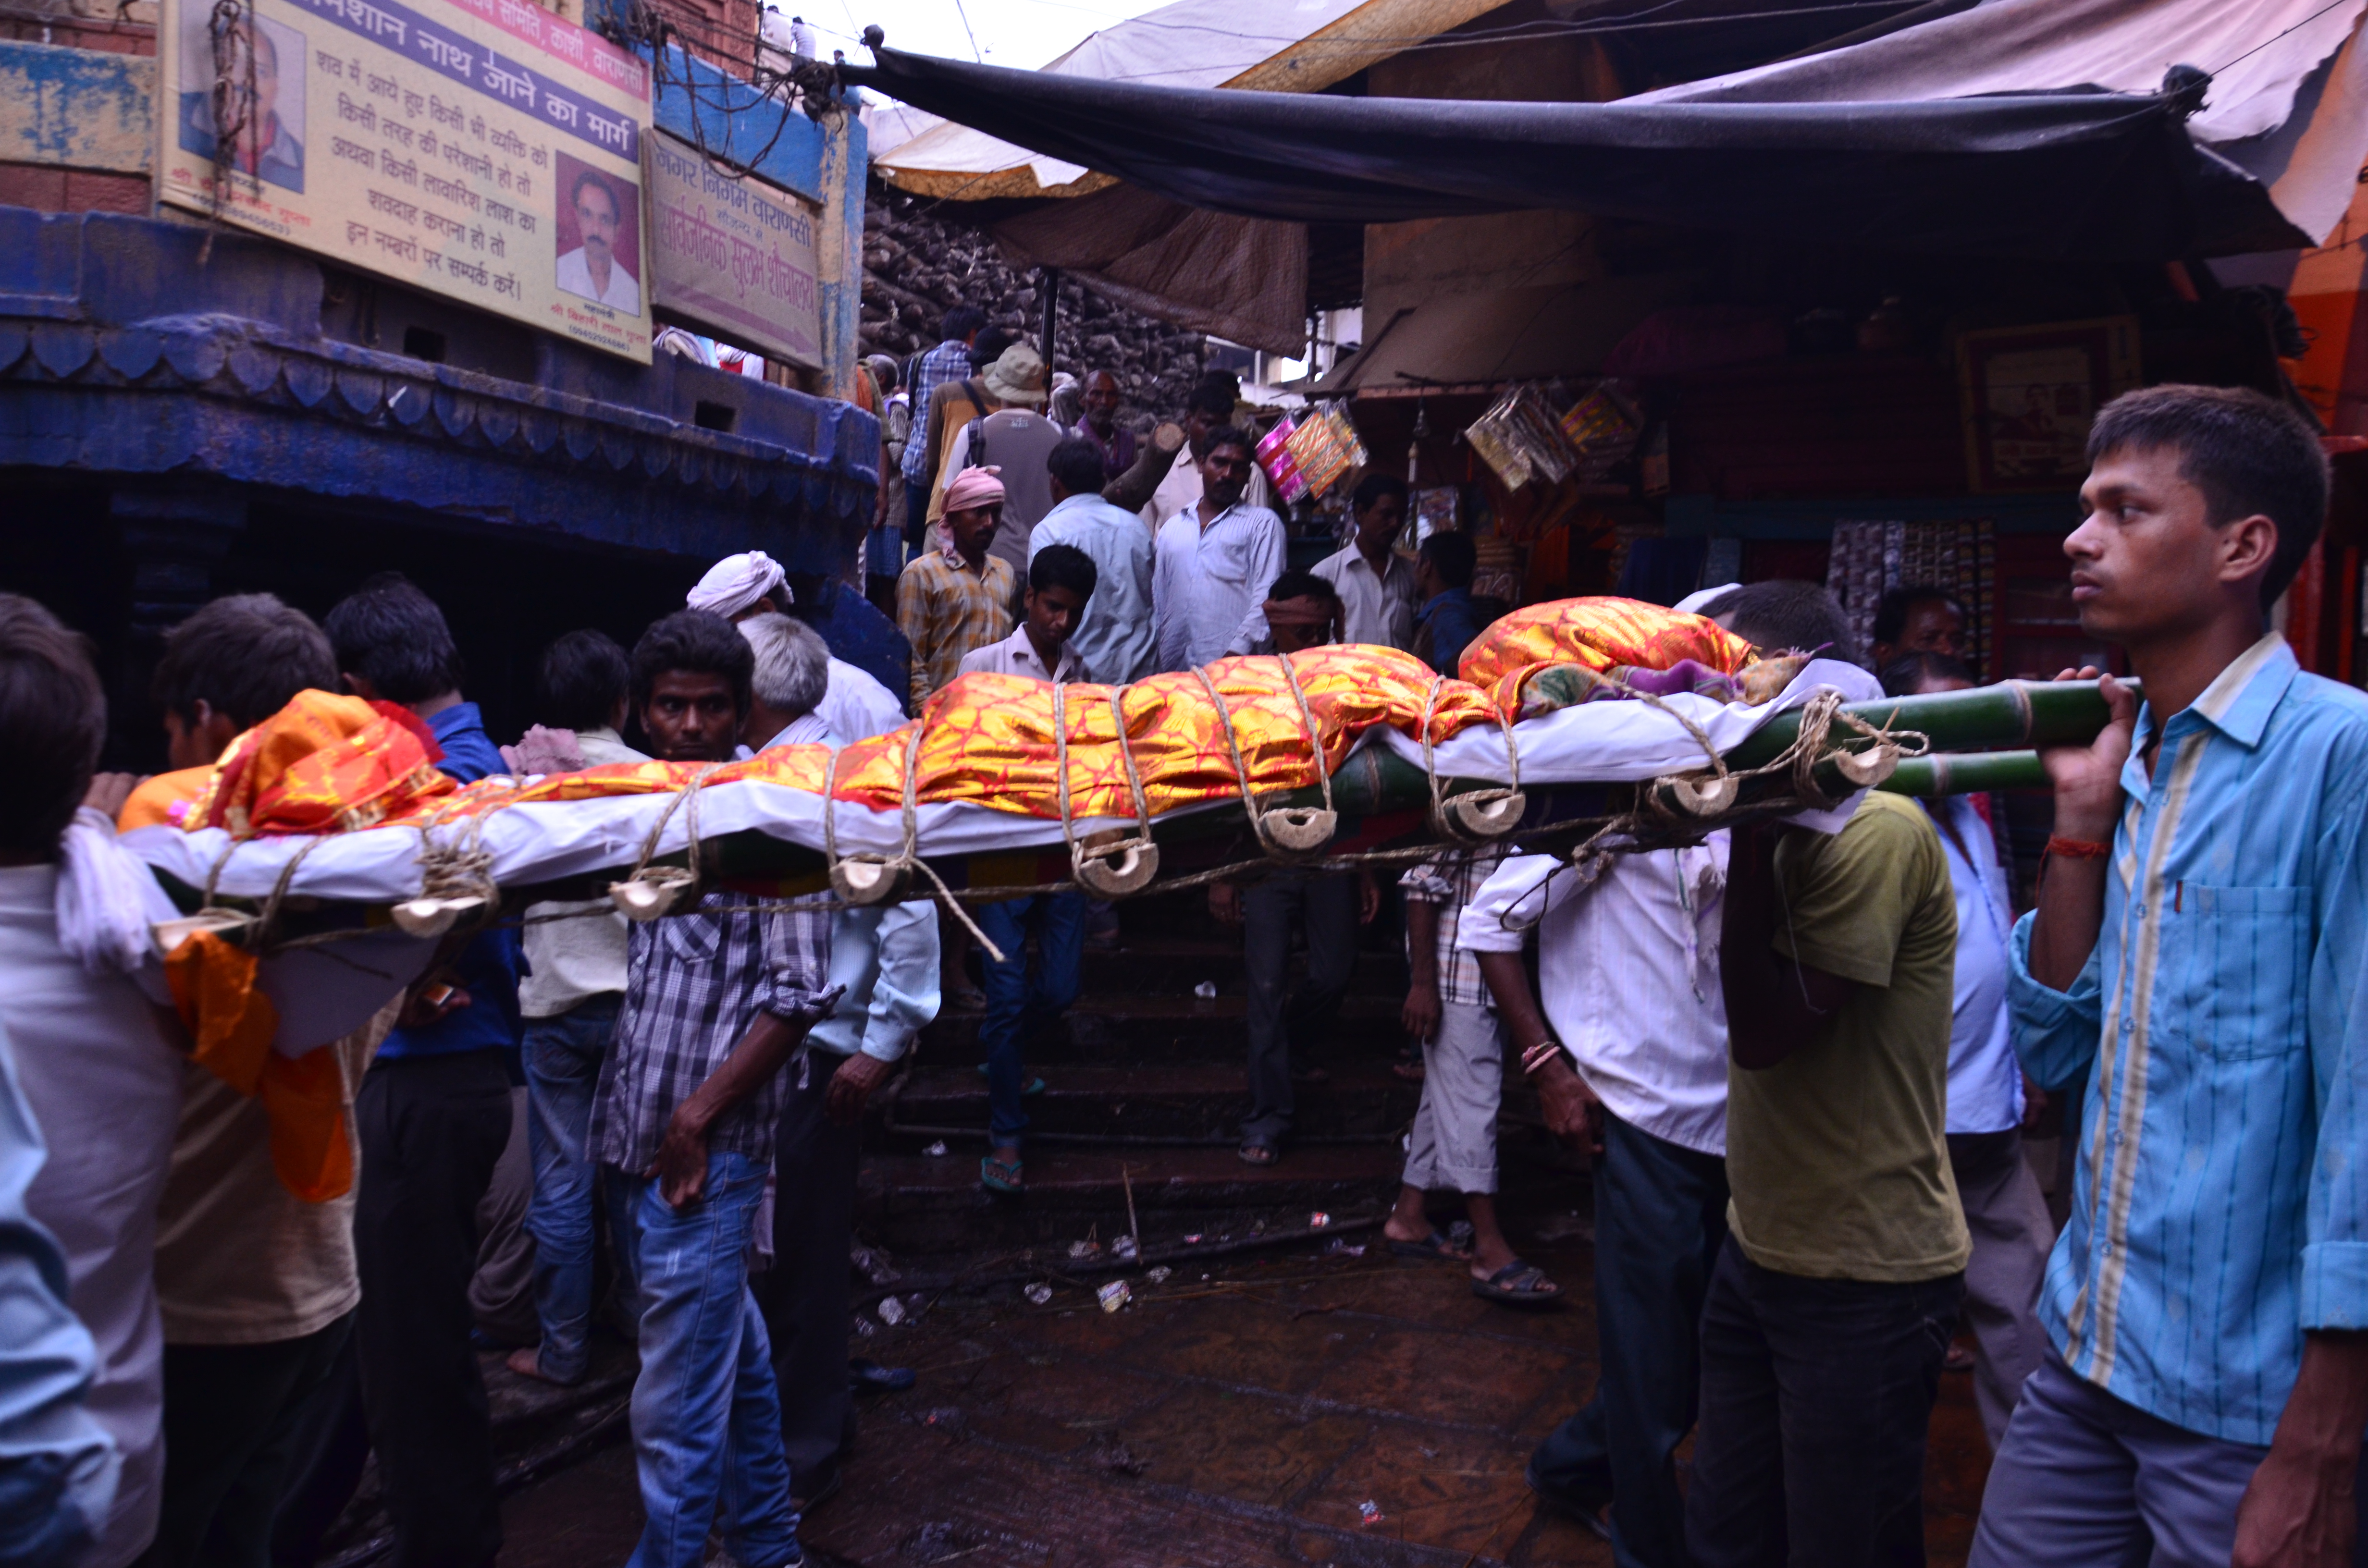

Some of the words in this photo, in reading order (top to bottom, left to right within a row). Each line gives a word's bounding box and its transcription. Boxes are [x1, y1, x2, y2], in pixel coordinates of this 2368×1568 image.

[316, 49, 343, 78] शव
[429, 95, 464, 132] किसी
[469, 114, 485, 141] भी
[530, 143, 548, 169] को
[417, 29, 473, 78] नाथ
[545, 92, 579, 127] का
[586, 111, 630, 151] मार्ग
[332, 136, 375, 170] अथवा
[381, 147, 418, 187] किसी
[485, 198, 514, 225] लाश
[518, 210, 537, 234] का
[337, 91, 376, 131] किसी
[382, 118, 414, 148] तरह
[419, 129, 438, 158] की
[443, 141, 493, 181] परेशानी
[497, 163, 511, 189] हो
[517, 171, 531, 196] तो
[367, 188, 419, 226] शवदाह
[423, 209, 466, 243] कराना
[470, 224, 485, 251] हो
[490, 231, 505, 258] तो
[656, 144, 698, 189] नगर
[701, 158, 748, 214] निगम
[752, 194, 811, 248] वाराणसी
[346, 219, 370, 246] इन
[422, 247, 443, 271] पर
[447, 256, 489, 286] सम्पर्क
[730, 234, 765, 299] सुलभ
